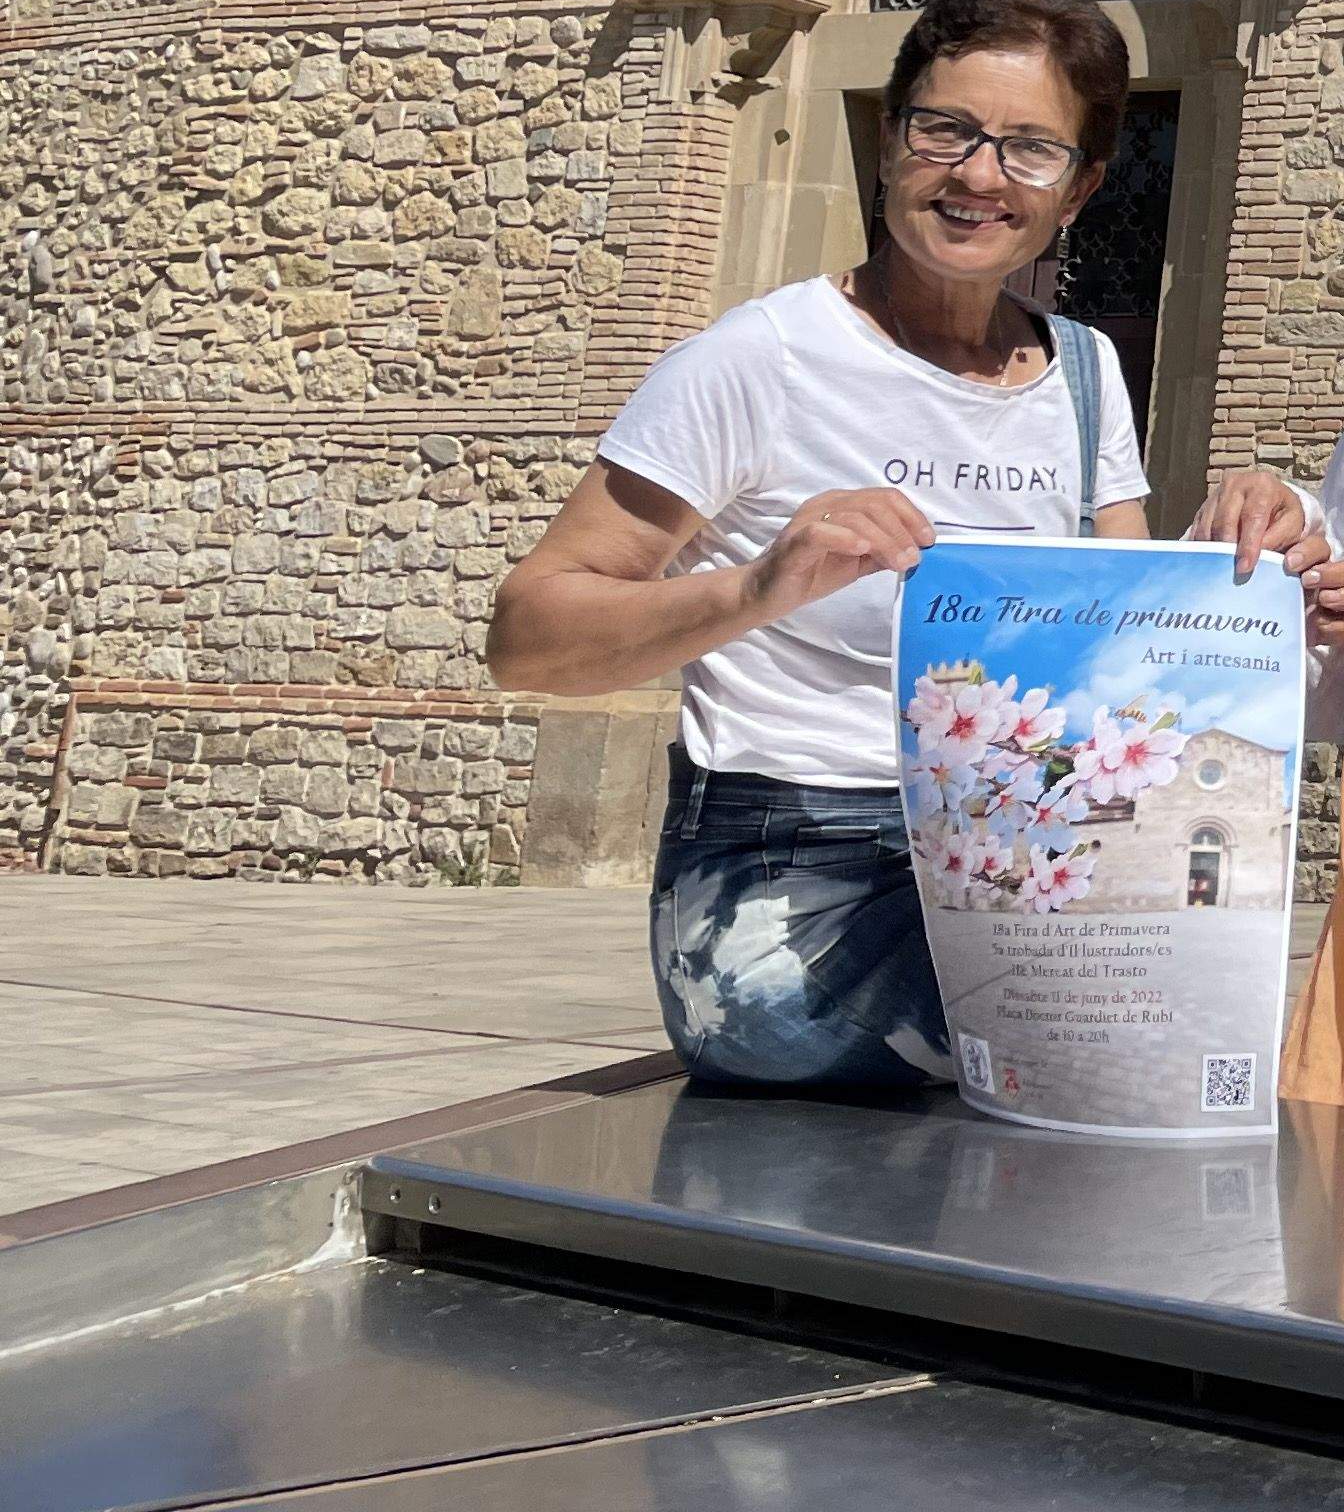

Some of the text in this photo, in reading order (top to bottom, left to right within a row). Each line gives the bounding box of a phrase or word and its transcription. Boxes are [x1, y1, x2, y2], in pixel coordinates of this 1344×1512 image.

[884, 458, 934, 487] OH
[922, 593, 1282, 638] 18a Fira de primavera
[1140, 647, 1176, 665] Art
[1180, 649, 1189, 666] i
[1079, 923, 1094, 937] de
[1100, 923, 1170, 936] Primavera
[1078, 965, 1097, 978] del
[1103, 965, 1147, 977] Trasto
[1064, 991, 1078, 1003] de
[1081, 993, 1108, 1007] juny
[1112, 991, 1126, 1004] de
[1130, 991, 1162, 1004] 2022
[1122, 1011, 1136, 1023] de
